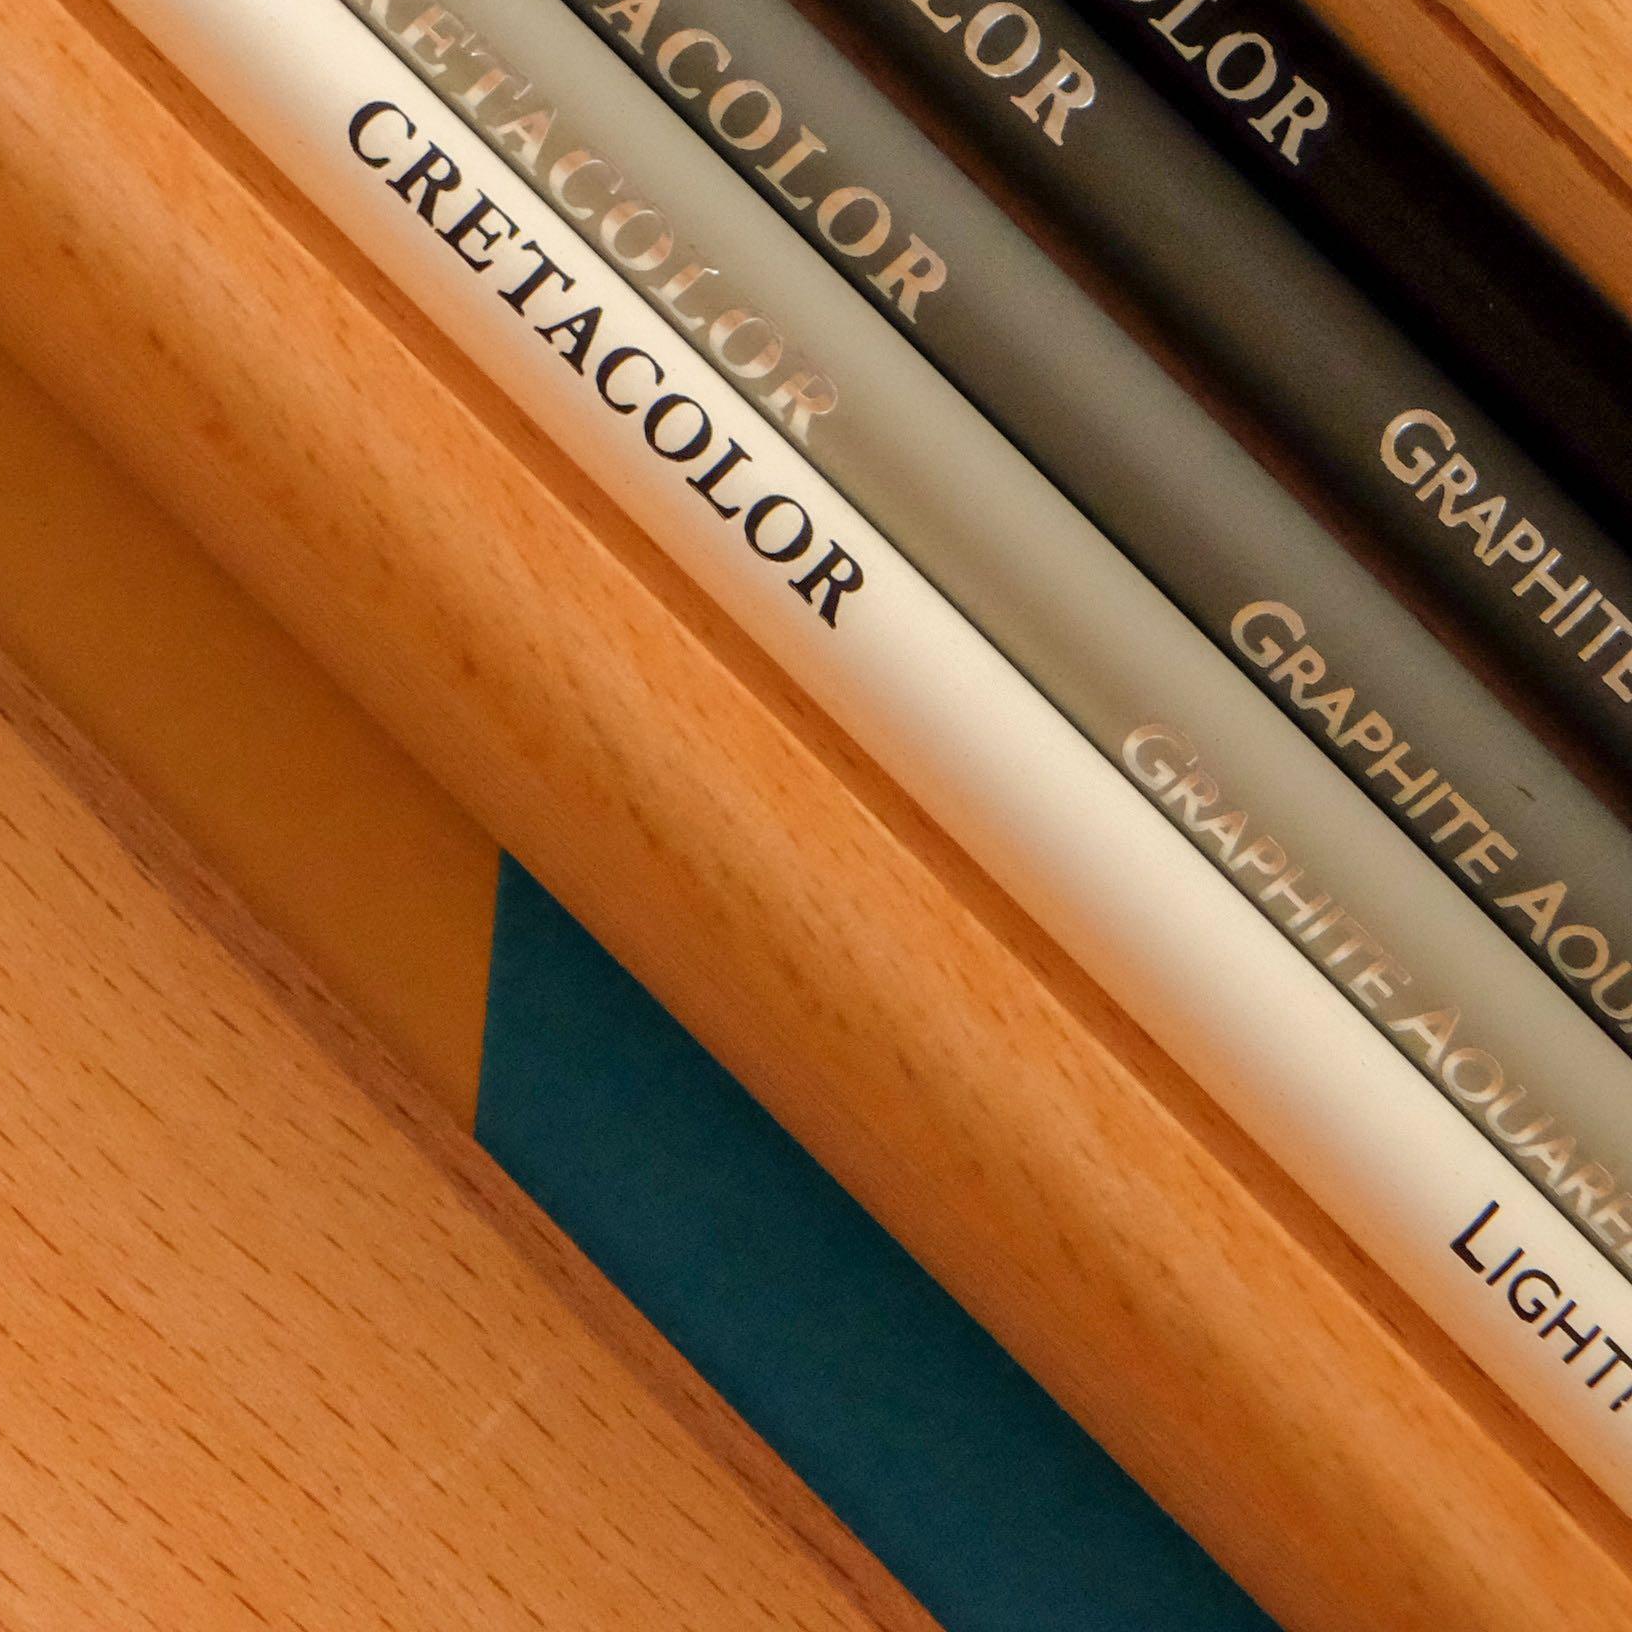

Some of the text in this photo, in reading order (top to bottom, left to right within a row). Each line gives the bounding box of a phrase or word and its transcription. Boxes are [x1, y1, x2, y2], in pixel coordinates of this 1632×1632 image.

[346, 99, 865, 630] CRETACOLOR
[1122, 723, 1632, 1272] GRAPHITE AQUARE
[1230, 600, 1632, 1035] GRAPHITE AQU
